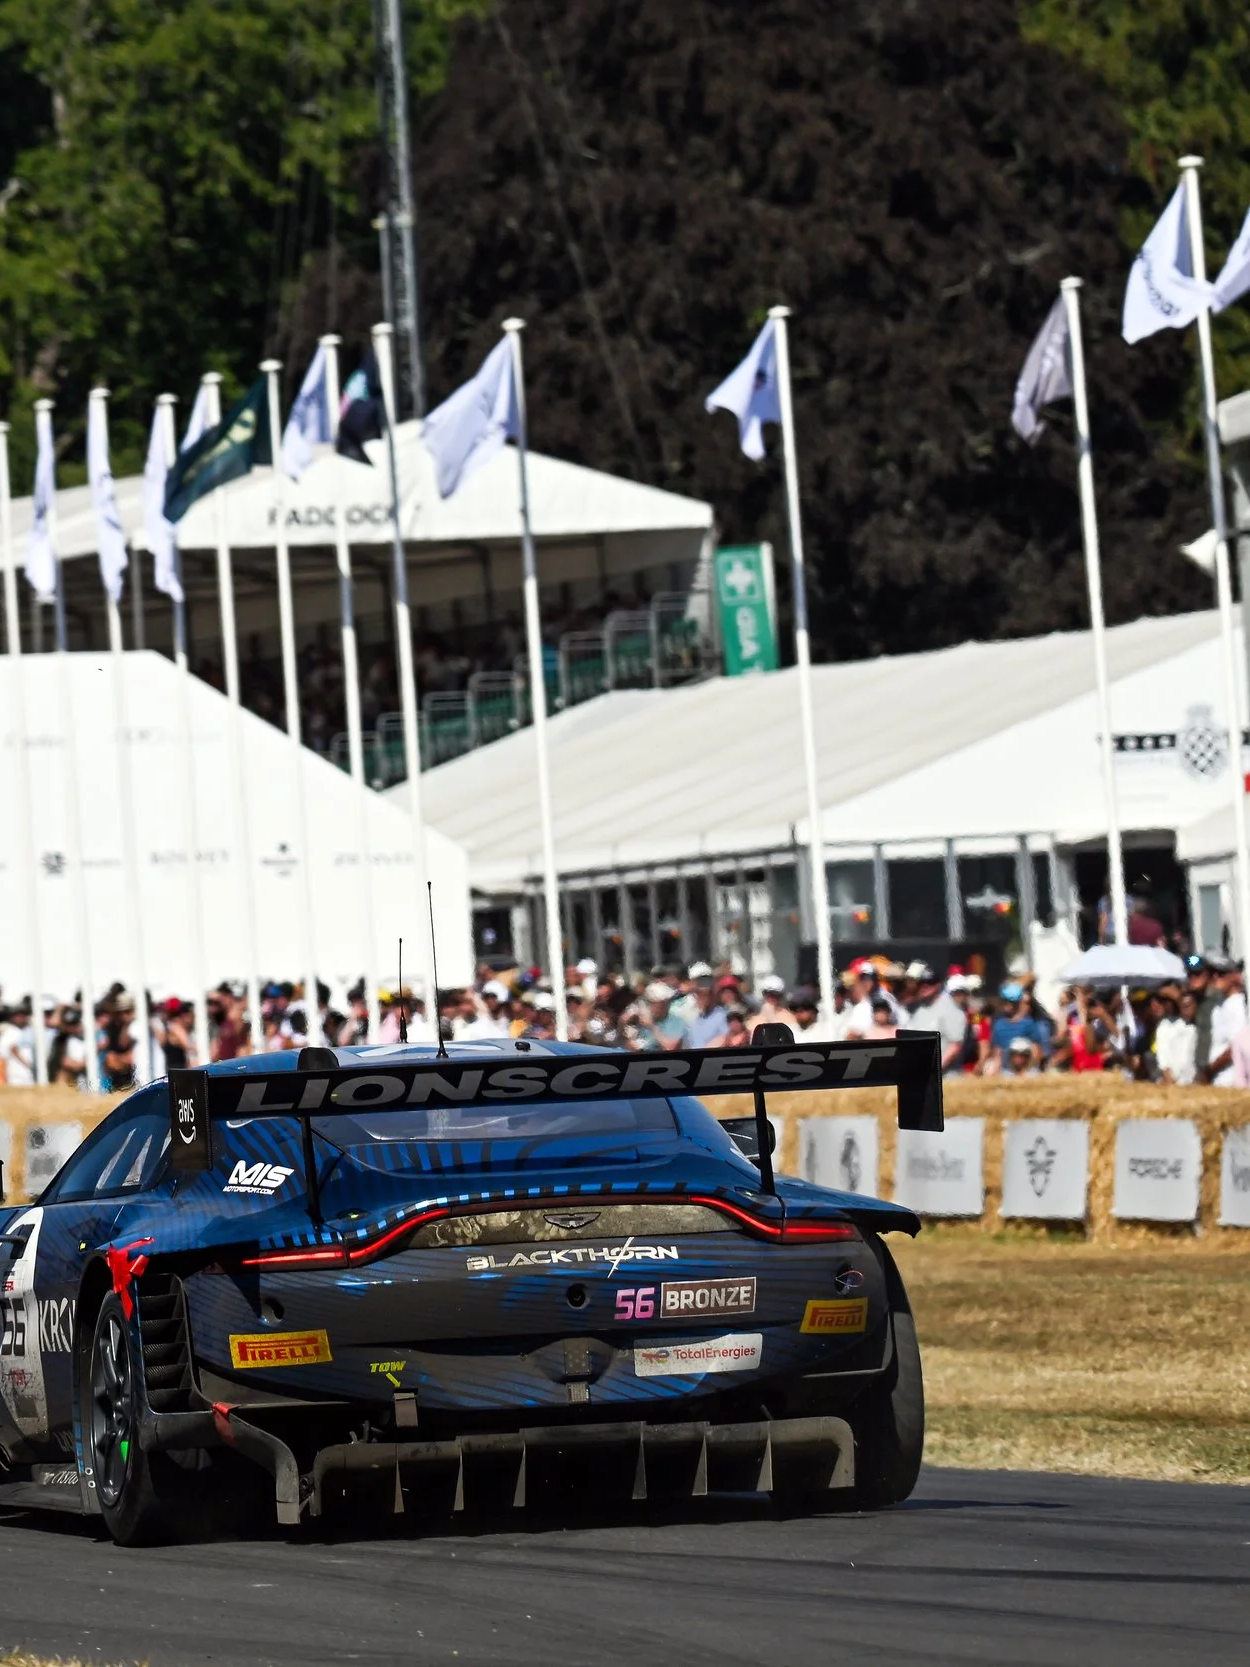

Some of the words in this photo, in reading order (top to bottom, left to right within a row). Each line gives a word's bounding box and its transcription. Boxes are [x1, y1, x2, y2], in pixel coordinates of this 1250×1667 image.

[235, 1047, 897, 1113] LIONSCREST
[178, 1098, 195, 1123] aws
[228, 1160, 295, 1188] MIS
[466, 1239, 679, 1276] BLACKTHORN
[614, 1287, 655, 1320] 56
[665, 1285, 752, 1311] BRONZE
[809, 1305, 863, 1327] PIRELLI
[238, 1337, 320, 1361] PIRELLI
[672, 1345, 756, 1361] TotalEnergies
[369, 1360, 406, 1373] TOW
